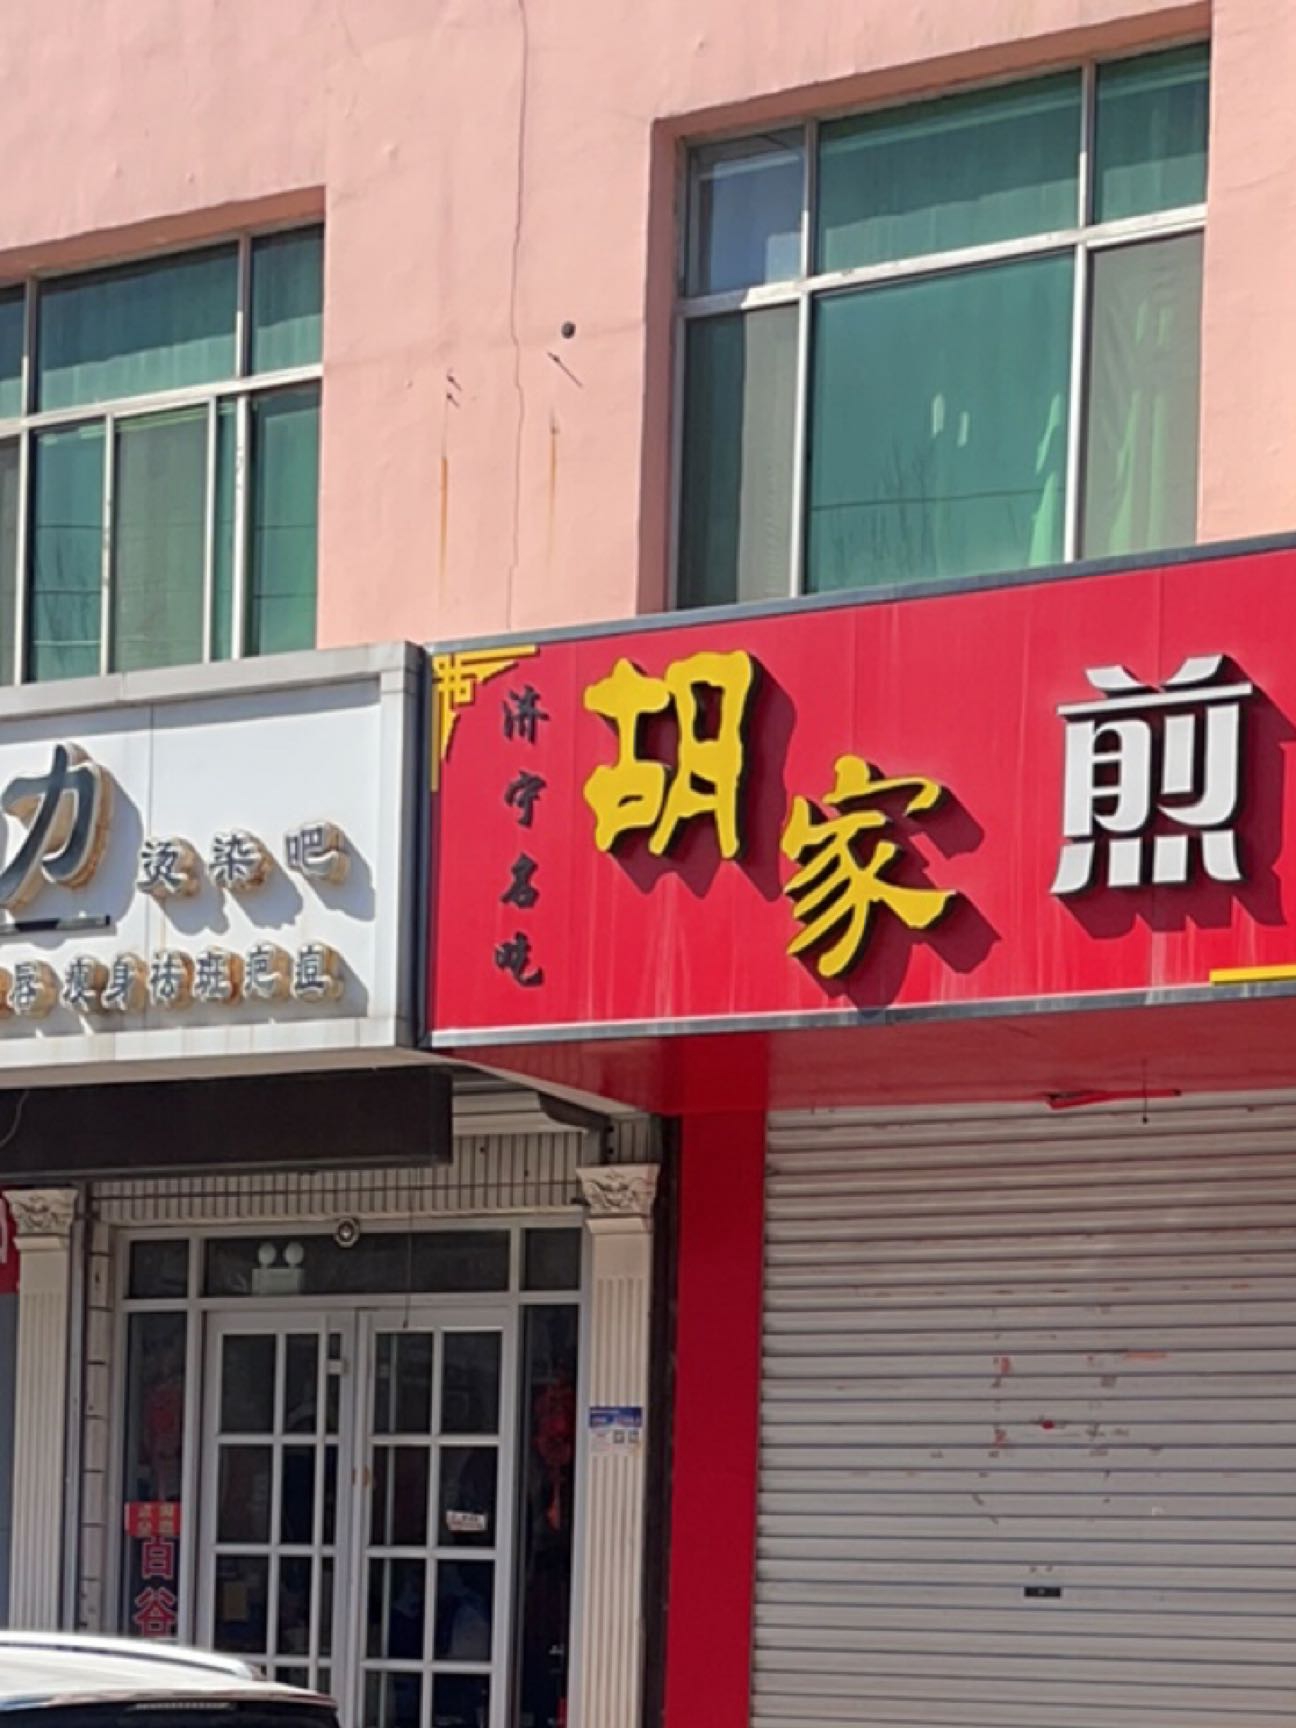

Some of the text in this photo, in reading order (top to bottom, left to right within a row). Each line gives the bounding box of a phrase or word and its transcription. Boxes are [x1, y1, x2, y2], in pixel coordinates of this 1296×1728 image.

[137, 824, 339, 893] 烫染吧
[494, 684, 550, 989] 济宁名吃
